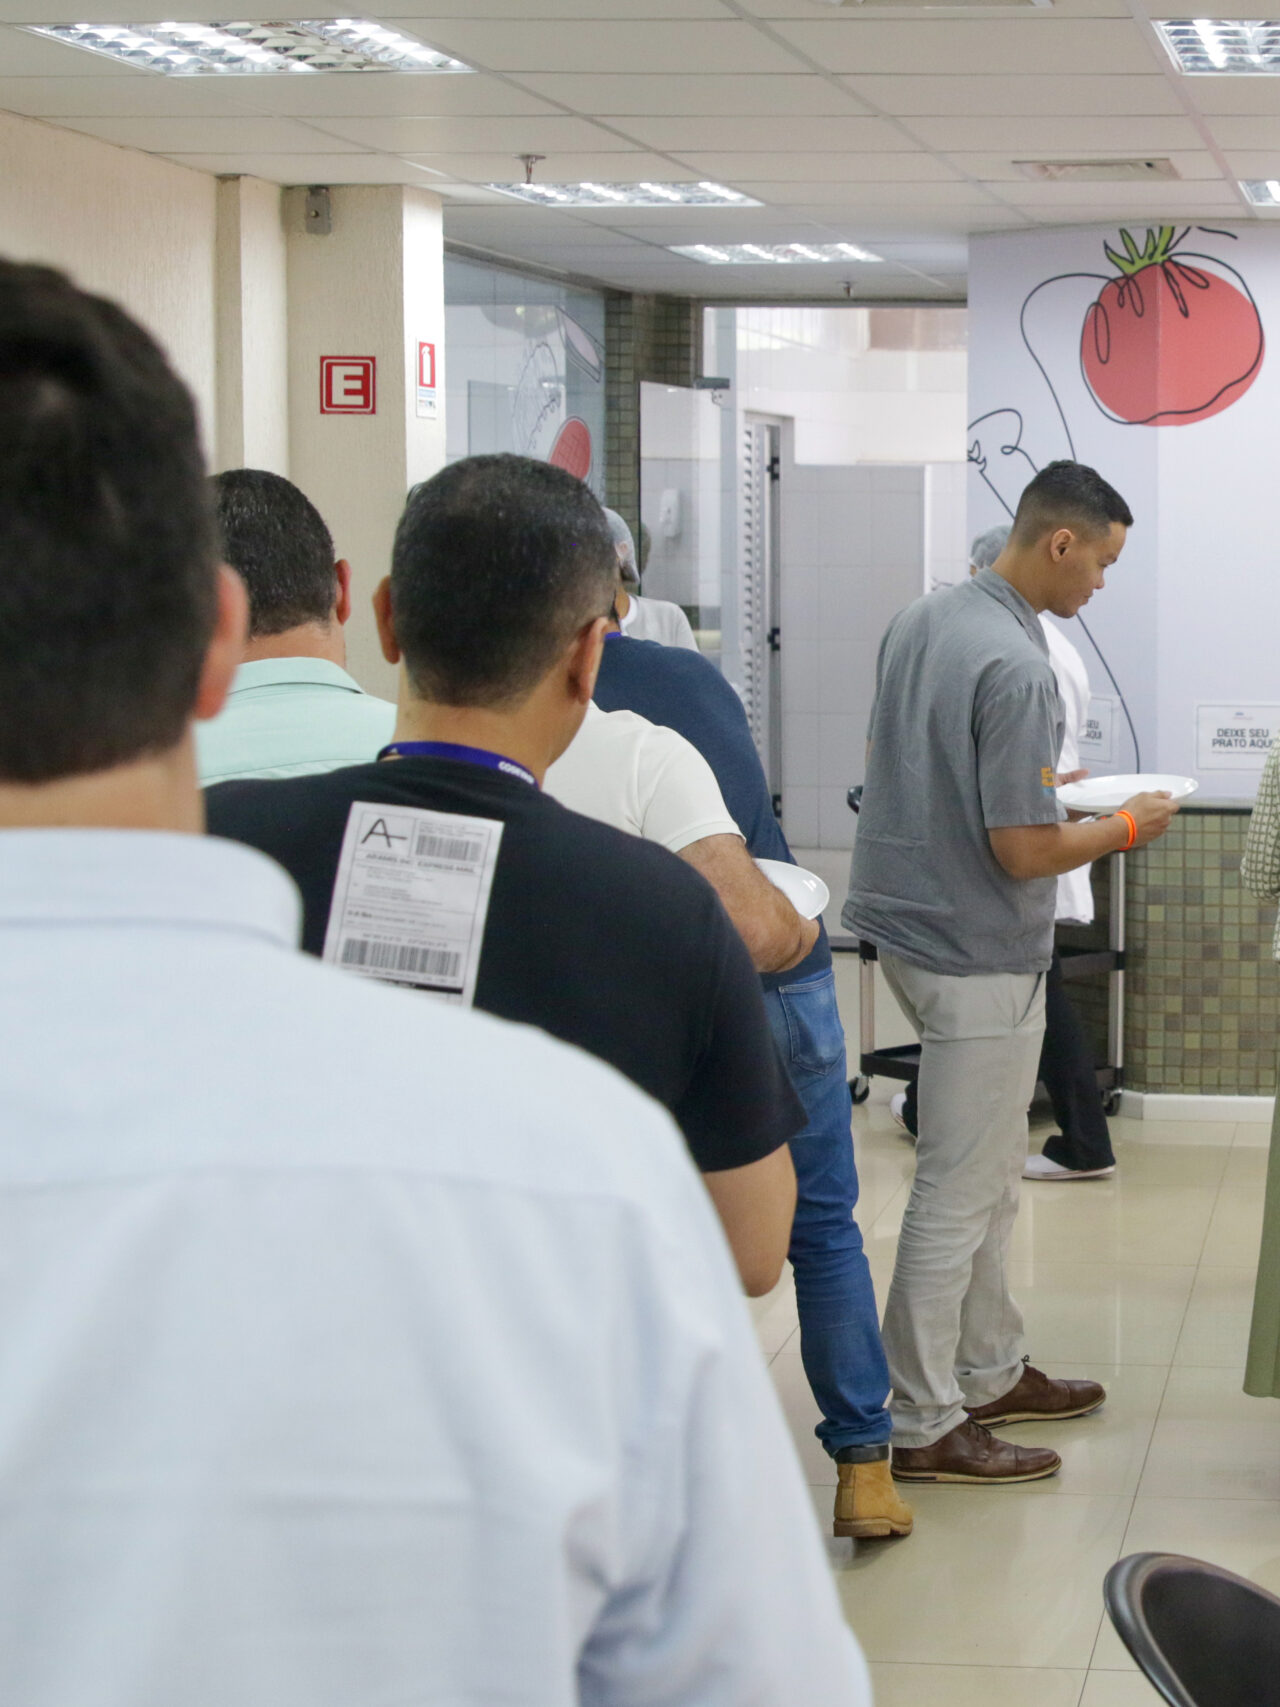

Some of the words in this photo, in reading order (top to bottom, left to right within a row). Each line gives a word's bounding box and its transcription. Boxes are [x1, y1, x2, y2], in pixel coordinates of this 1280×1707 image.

[332, 366, 364, 405] E
[1216, 728, 1246, 738] DEIXE
[1249, 728, 1269, 738] SEU
[1212, 738, 1247, 748] PRATO
